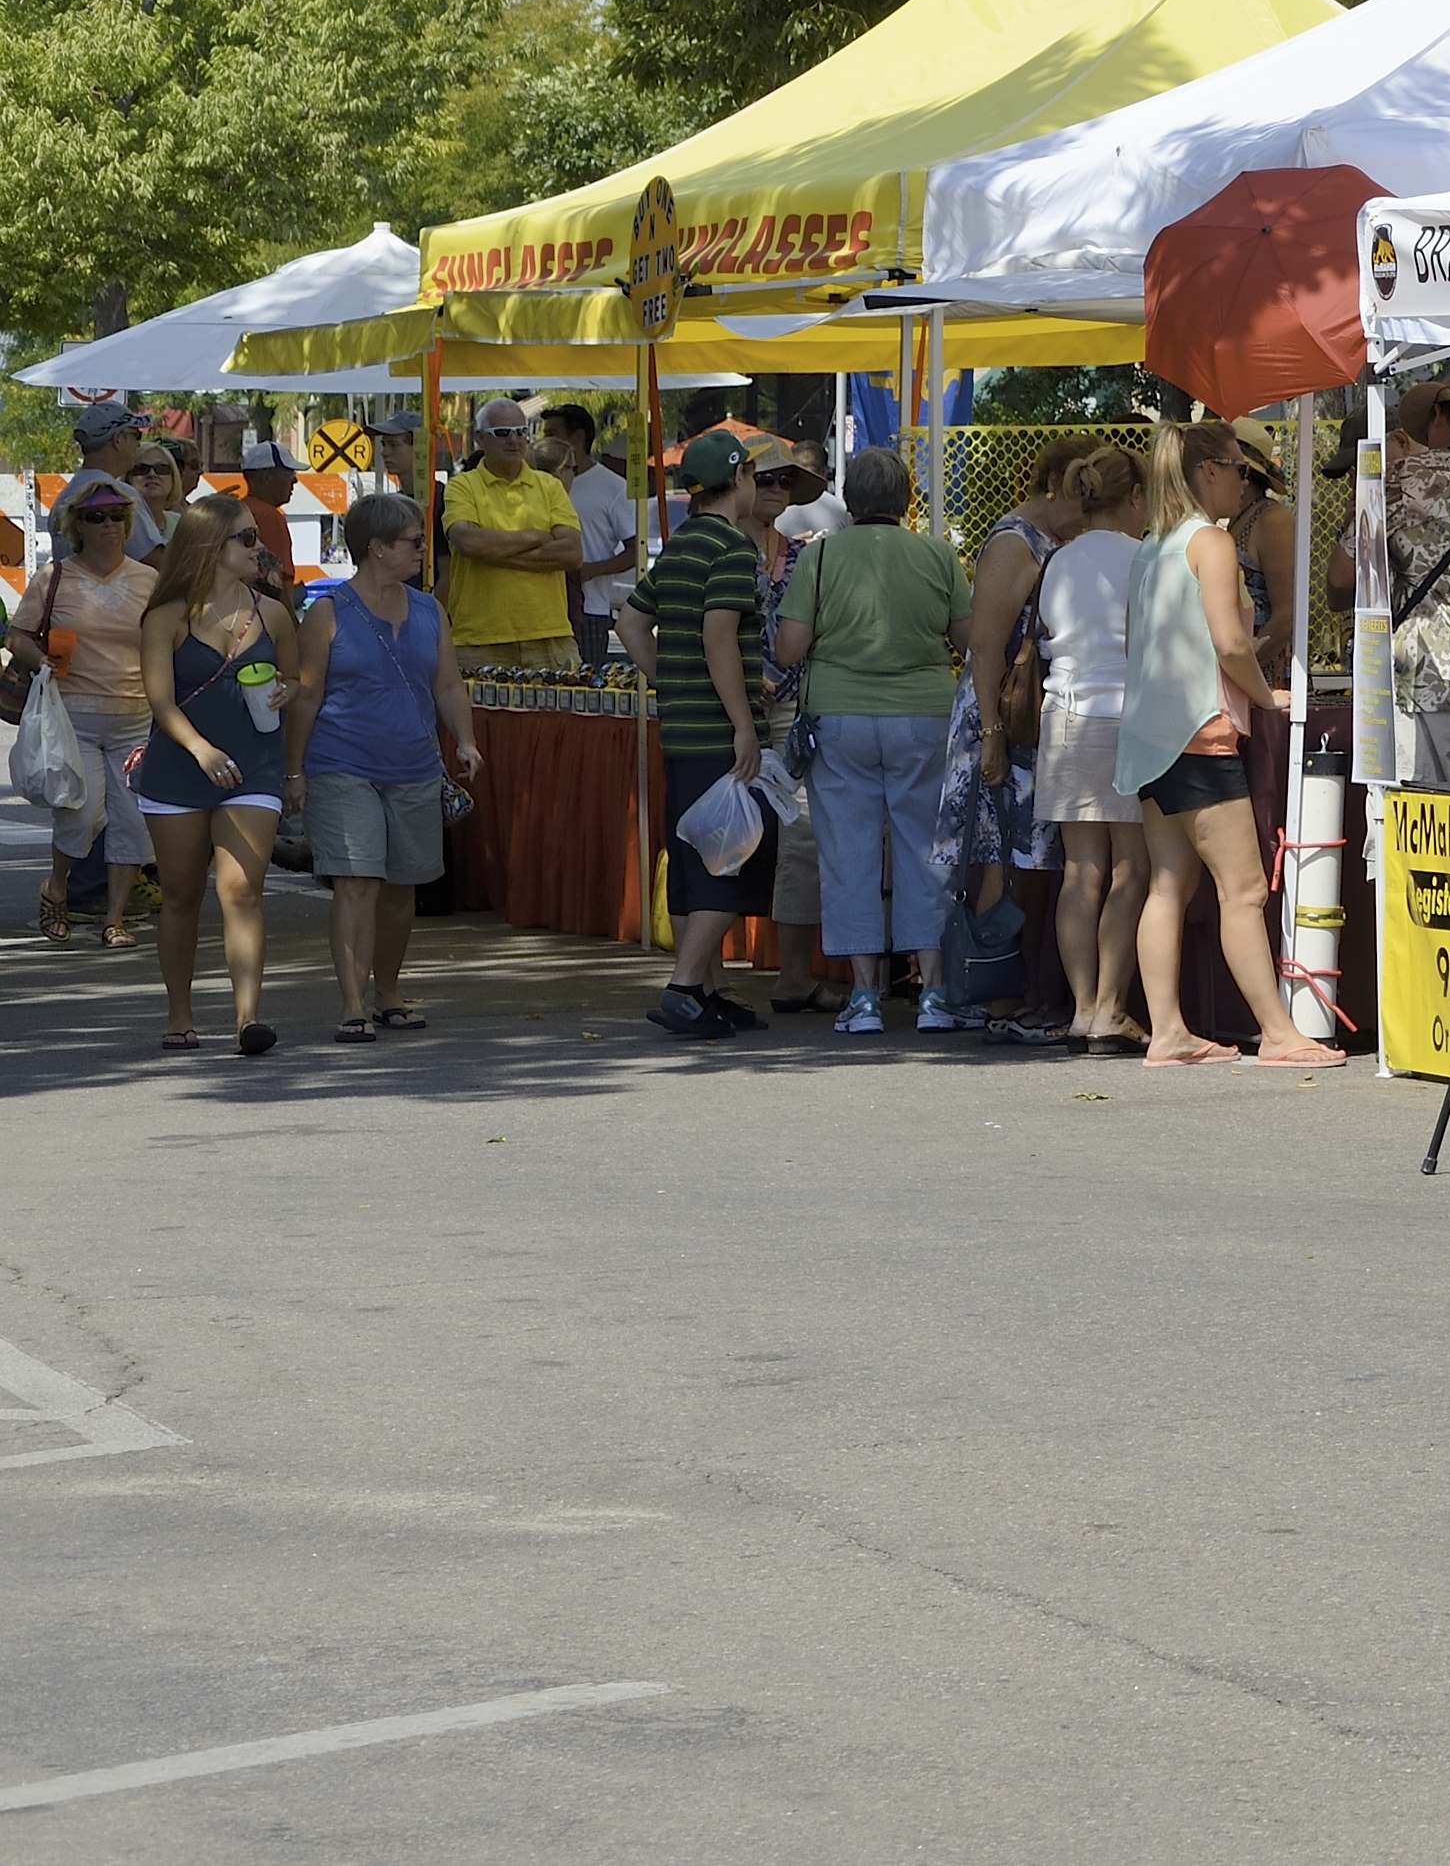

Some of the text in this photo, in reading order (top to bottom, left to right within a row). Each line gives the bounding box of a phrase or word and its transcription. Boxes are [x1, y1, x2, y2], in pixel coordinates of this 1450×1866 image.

[633, 176, 675, 241] BUY ONE
[648, 211, 656, 241] N
[678, 210, 873, 276] UNGLASSES
[632, 243, 675, 286] GET TWO
[642, 291, 668, 330] FREE
[313, 443, 366, 459] R R
[1432, 1014, 1450, 1053] Or
